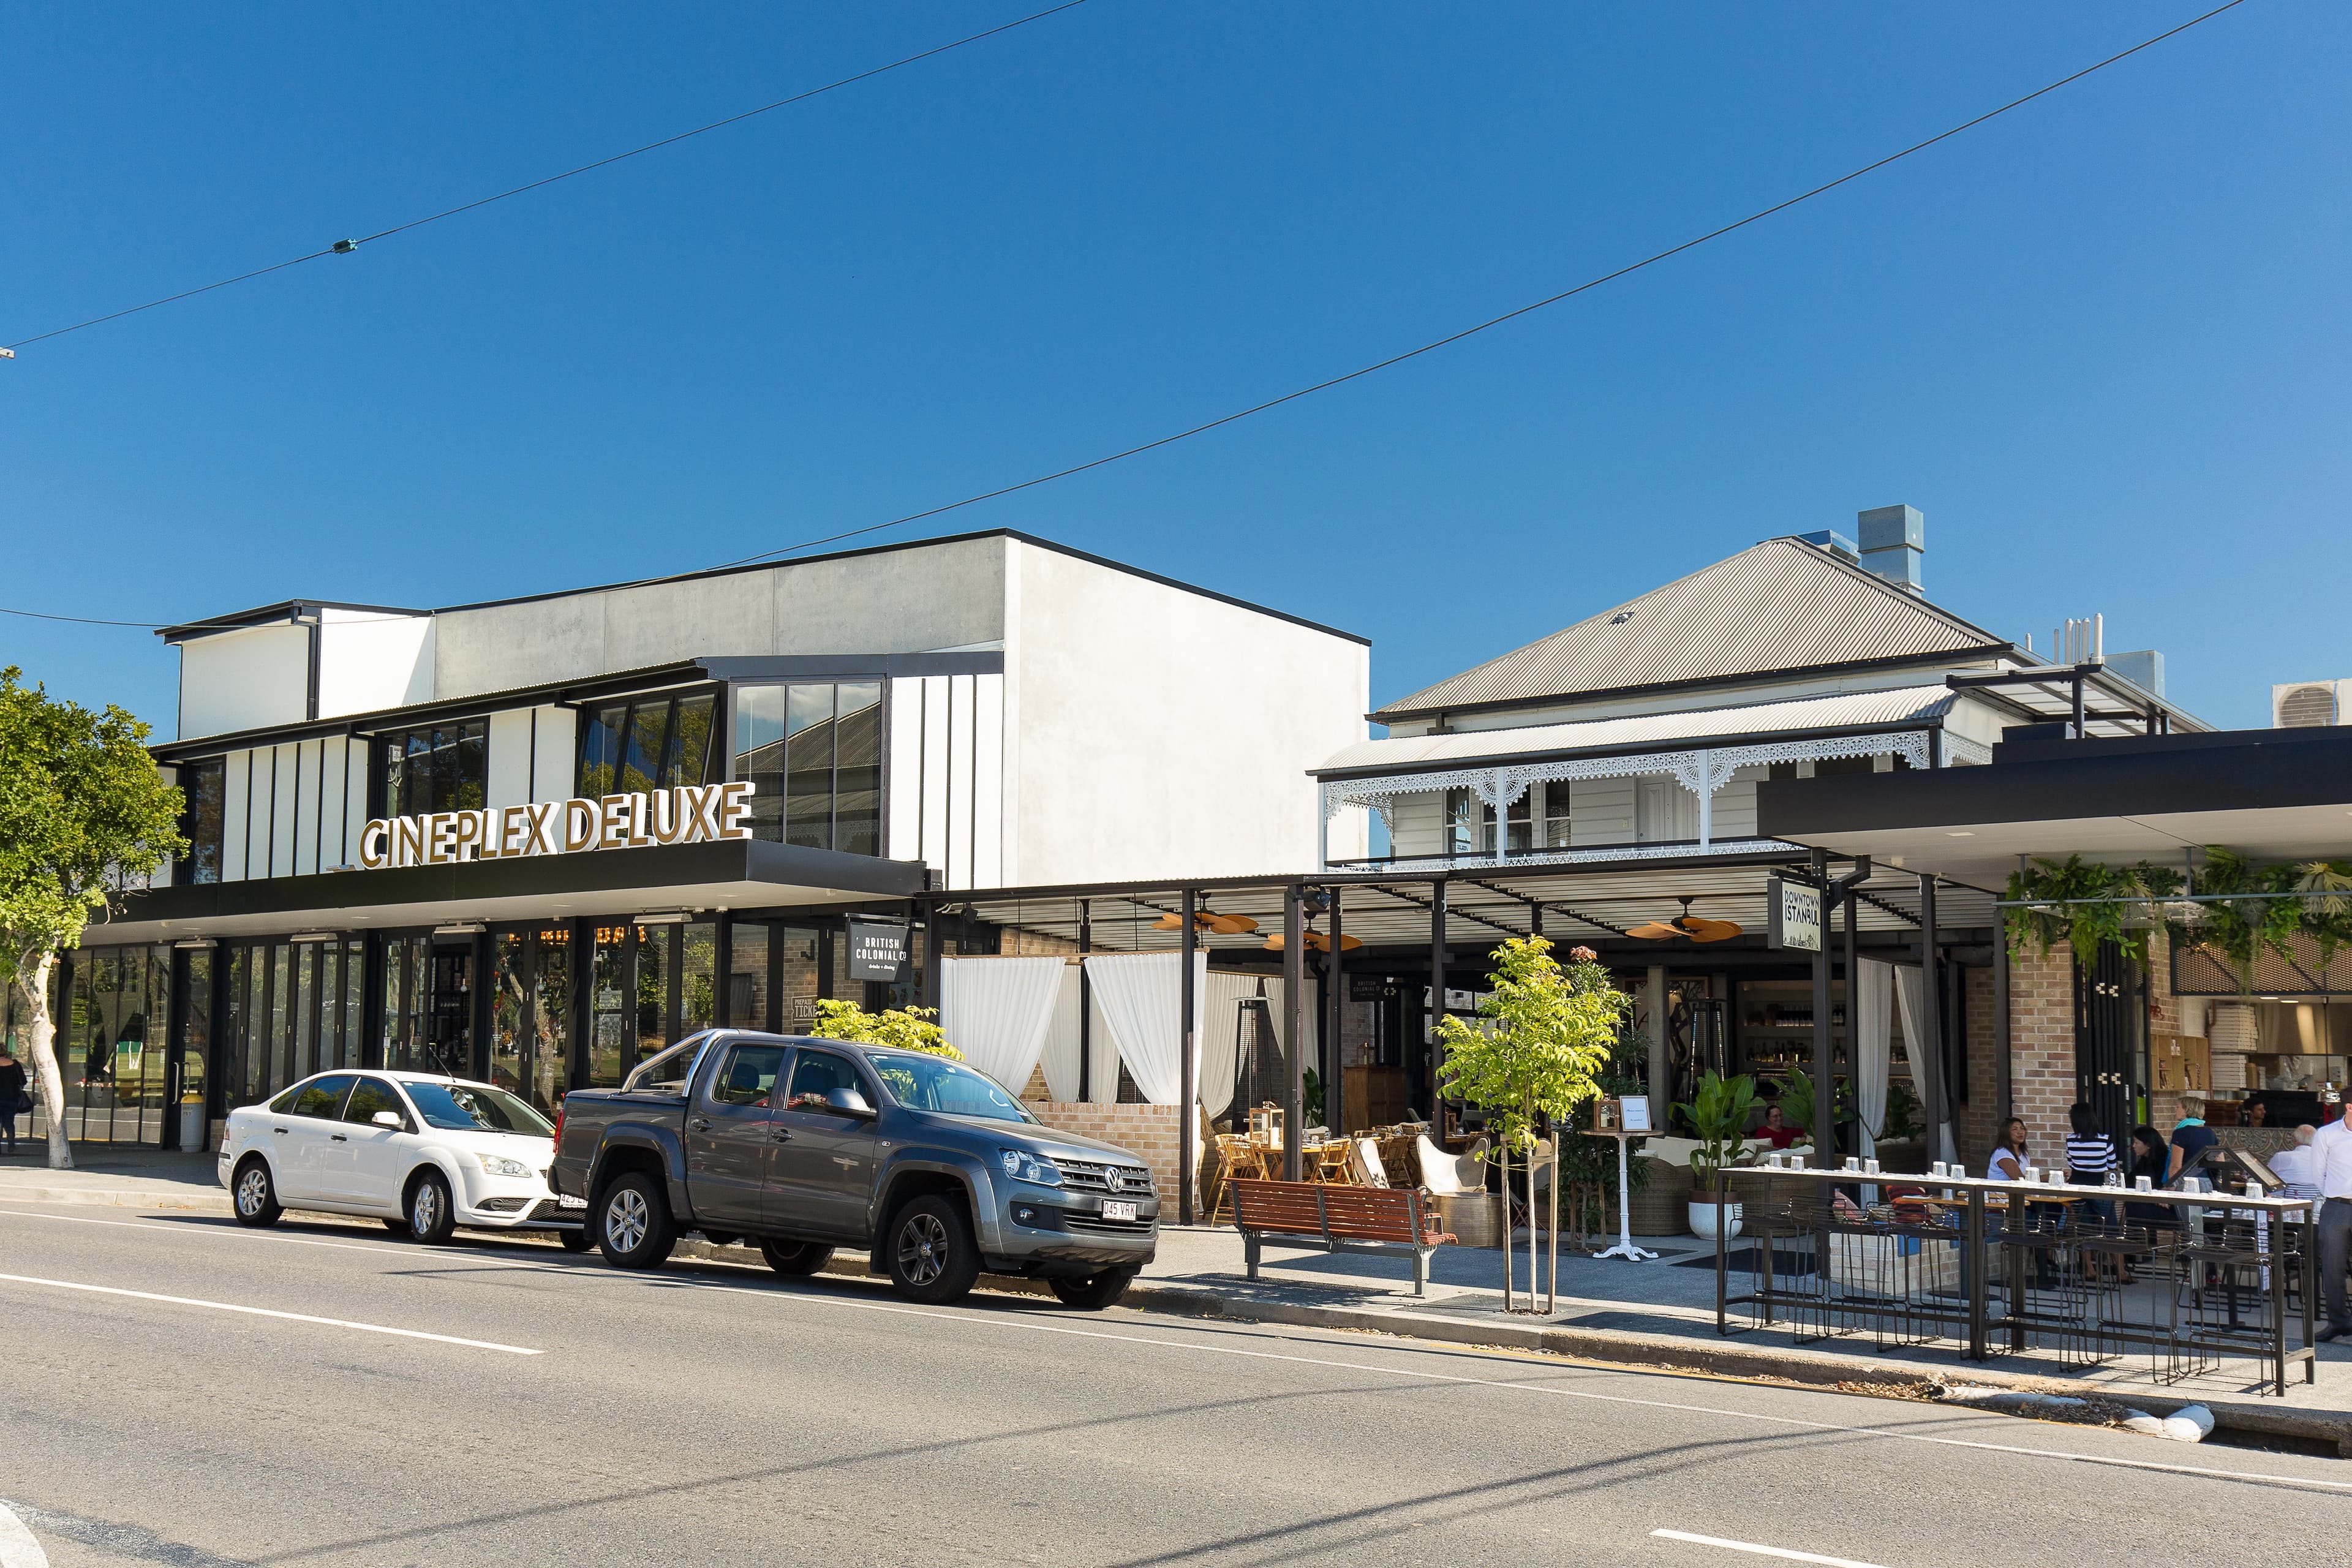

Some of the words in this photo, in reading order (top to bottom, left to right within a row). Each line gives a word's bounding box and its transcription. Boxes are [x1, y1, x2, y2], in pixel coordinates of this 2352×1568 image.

[359, 801, 561, 870] CINEPLEX
[565, 781, 756, 852] DELUXE
[1784, 890, 1819, 908] DOWNTOWN
[1785, 904, 1819, 927] ISTANBUL
[865, 937, 899, 949] BRITISH
[856, 949, 897, 961] COLONIAL
[795, 1005, 817, 1017] TICKE
[2109, 1172, 2117, 1184] 9
[1120, 1204, 1135, 1216] VRK
